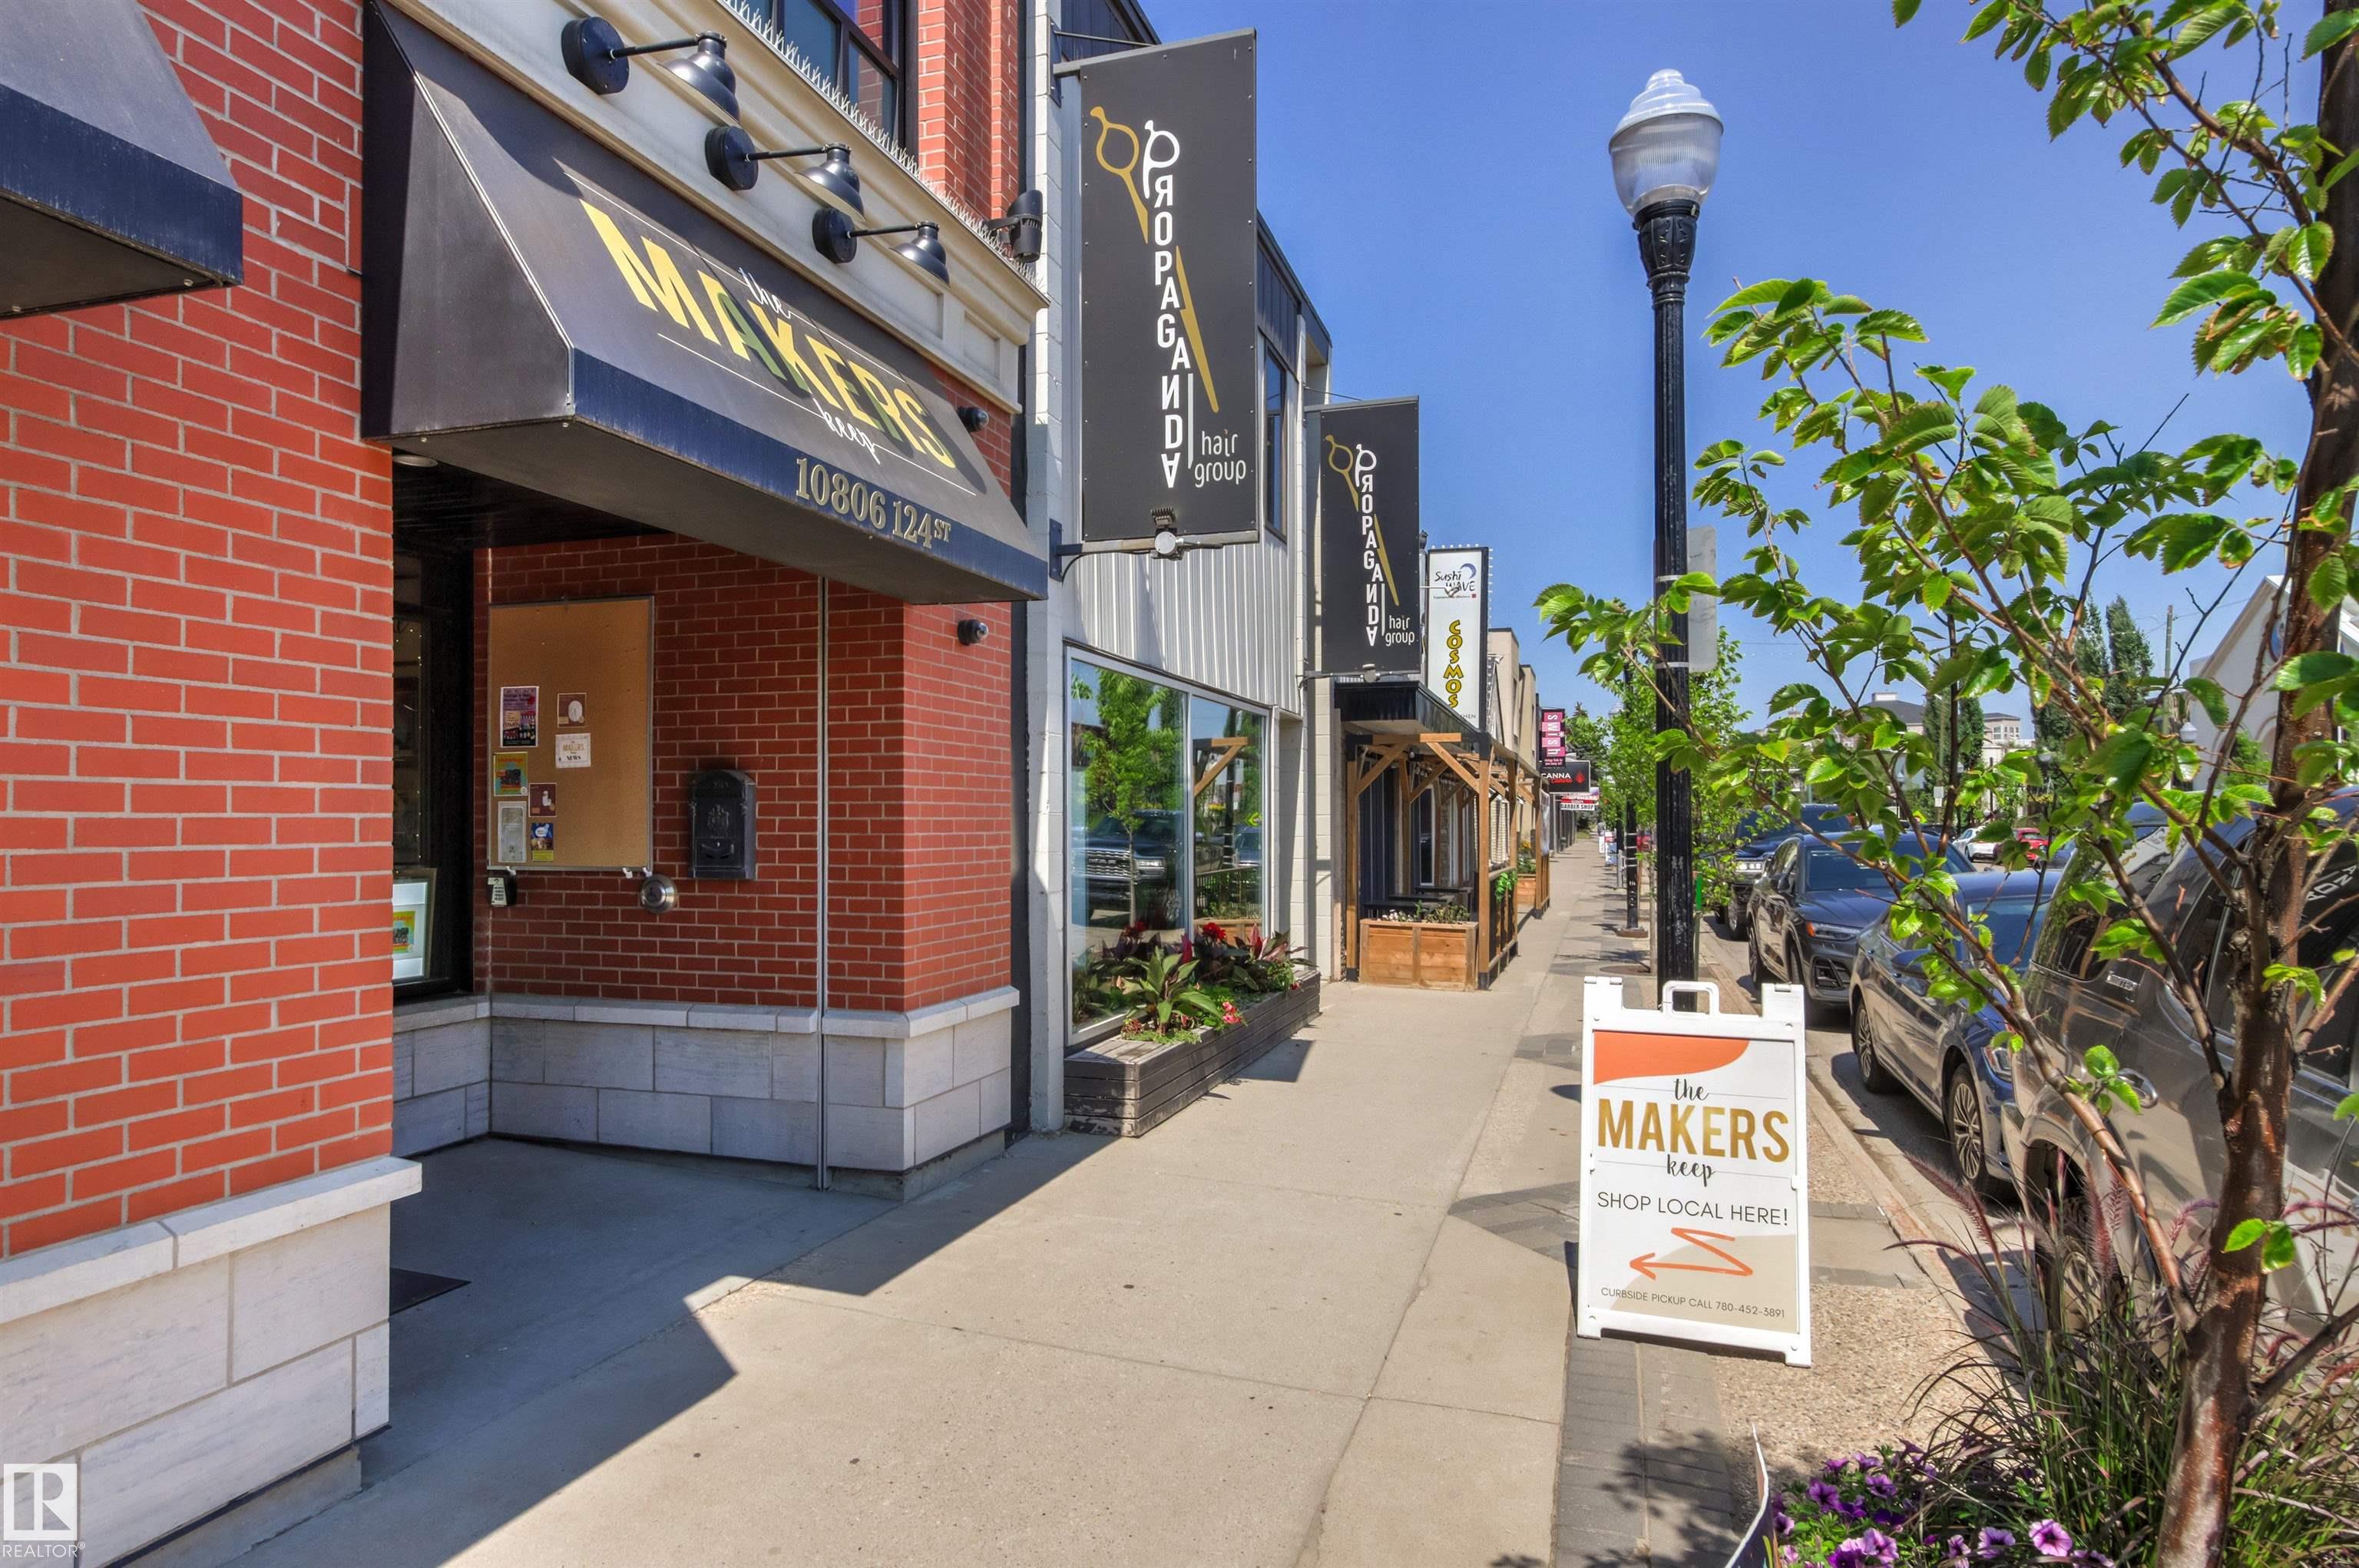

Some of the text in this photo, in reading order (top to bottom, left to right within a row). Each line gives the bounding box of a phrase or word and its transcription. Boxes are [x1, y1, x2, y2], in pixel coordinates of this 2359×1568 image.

[739, 267, 793, 319] the
[579, 197, 956, 469] MAKERS
[812, 398, 881, 465] keep
[1201, 429, 1238, 456] hair
[1194, 458, 1246, 489] group
[796, 458, 886, 529] 10806
[1385, 630, 1415, 647] group
[1388, 614, 1411, 630] hair
[1444, 620, 1464, 708] COSMOS
[1673, 1078, 1709, 1100] the
[1598, 1098, 1789, 1163] MAKERS
[1667, 1154, 1716, 1187] keep
[1597, 1192, 1788, 1226] SHOP LOCAL HERE!
[1601, 1287, 1785, 1318] CURBSIDE PICKUP CALL 780-452-3891
